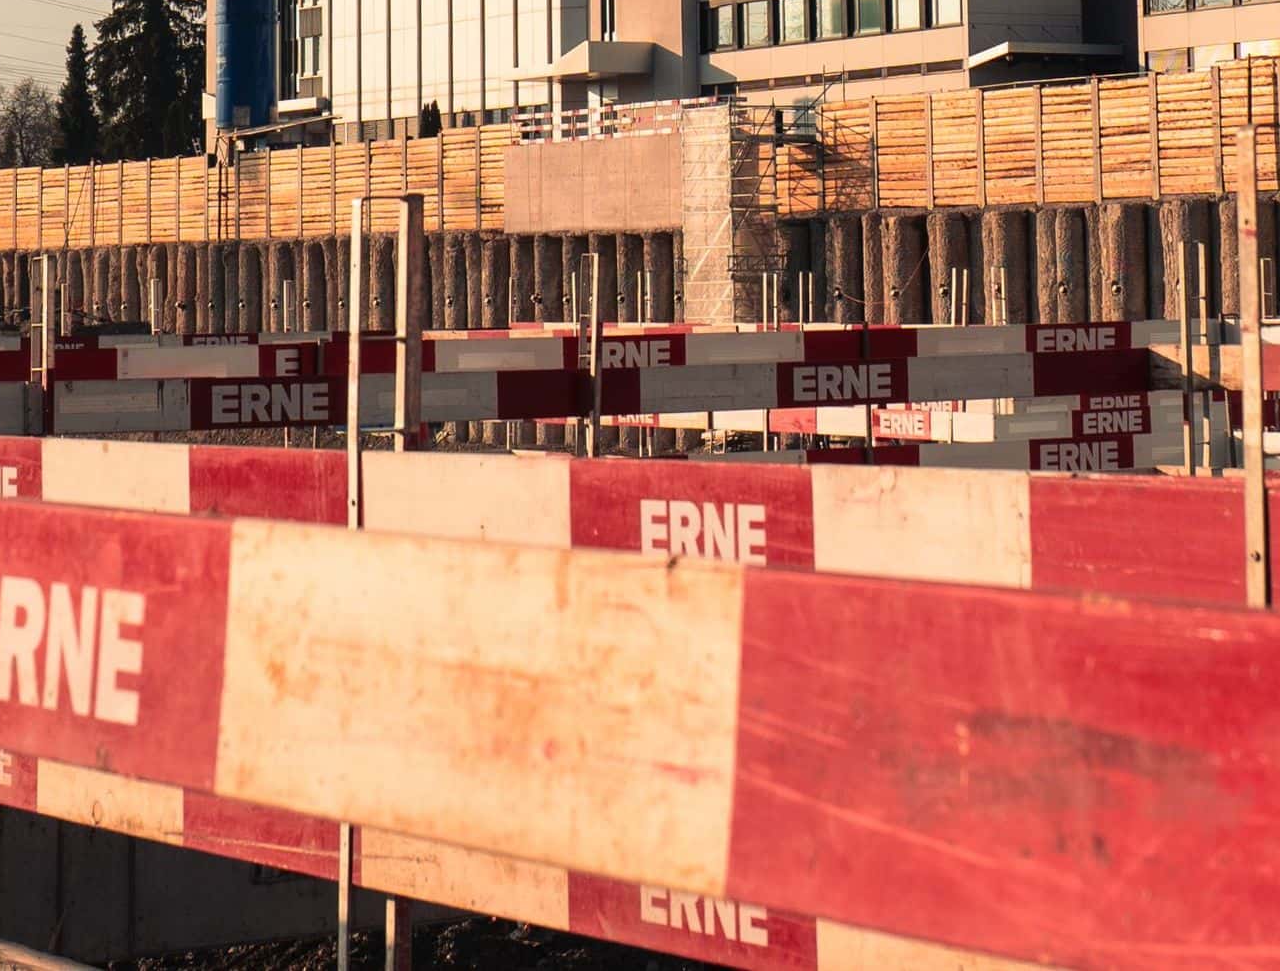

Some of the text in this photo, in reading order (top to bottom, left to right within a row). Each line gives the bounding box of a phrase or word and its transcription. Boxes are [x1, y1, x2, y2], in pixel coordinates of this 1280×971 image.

[1037, 328, 1115, 352] ERNE
[792, 364, 891, 401] ERNE
[212, 383, 328, 424] ERNE
[879, 412, 926, 436] ERNE
[1083, 410, 1142, 434] ERNE
[1040, 441, 1118, 471] ERNE
[640, 499, 767, 566] ERNE
[641, 885, 768, 947] ERNE
